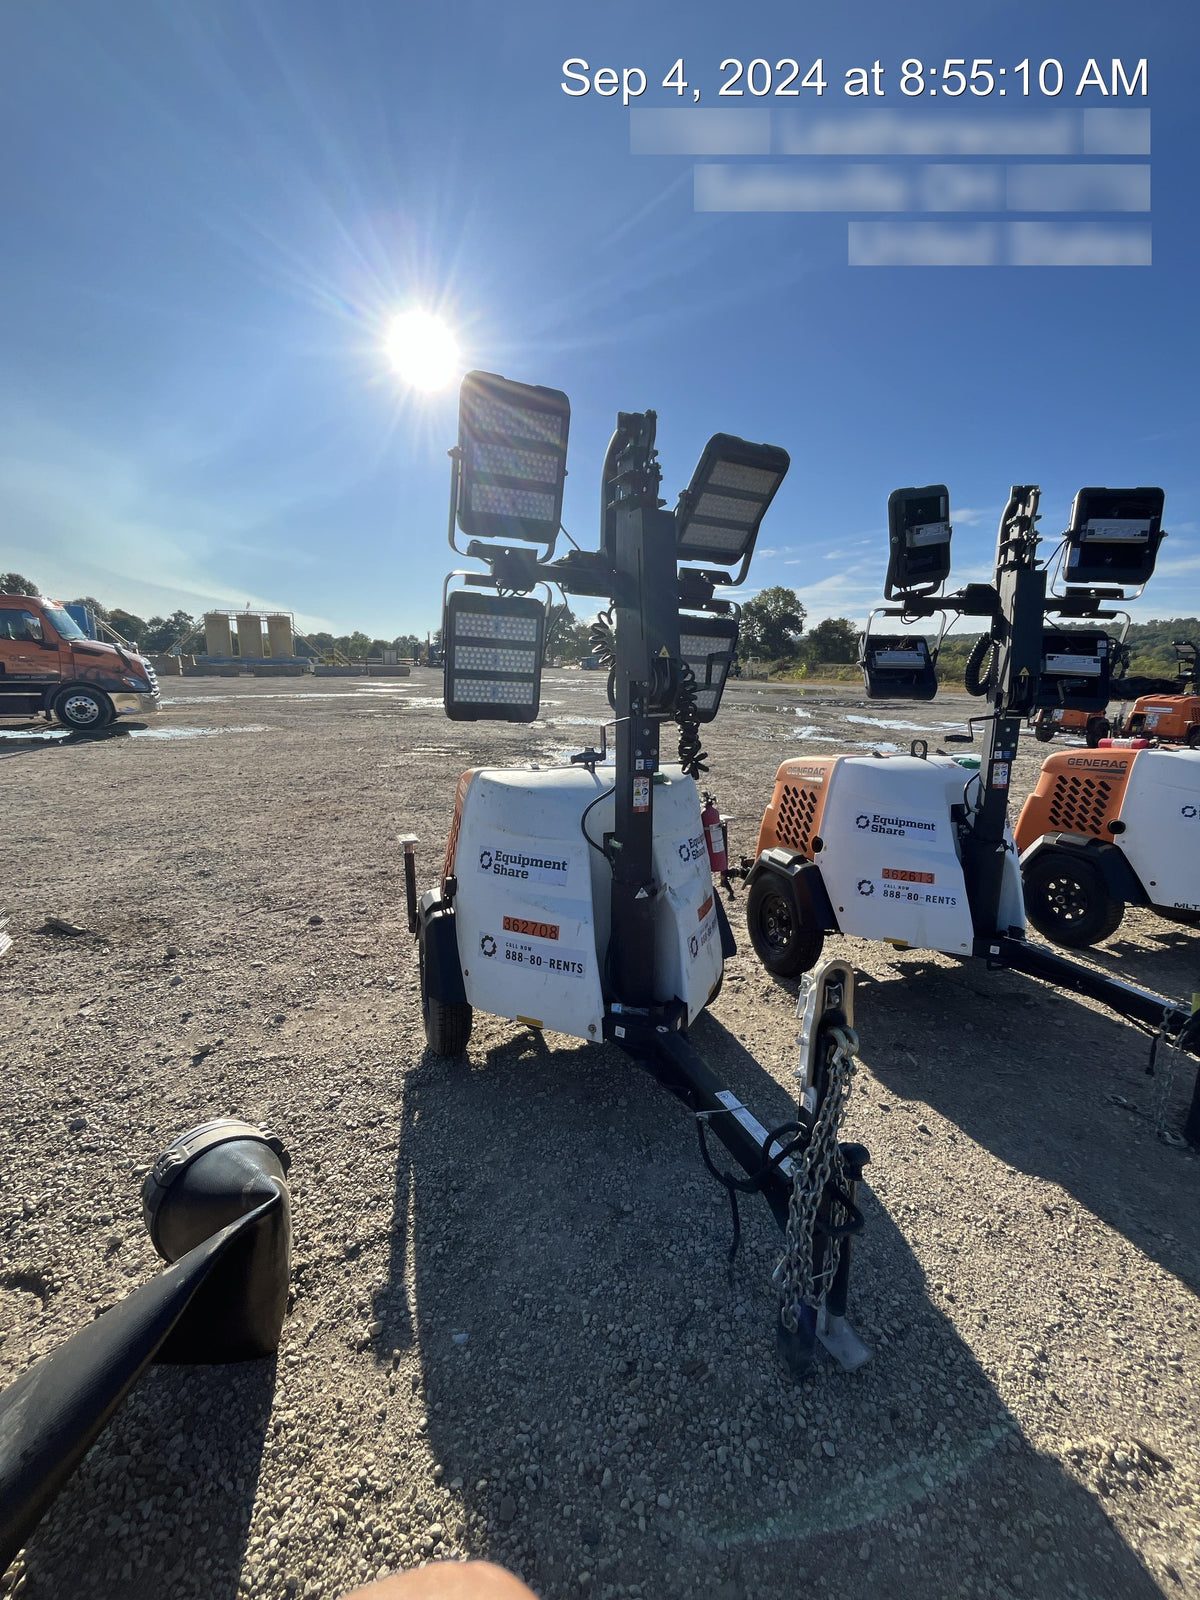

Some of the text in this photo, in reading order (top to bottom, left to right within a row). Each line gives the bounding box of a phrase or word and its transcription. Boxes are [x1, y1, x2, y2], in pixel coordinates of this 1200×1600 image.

[1067, 757, 1129, 769] GENERAC
[871, 824, 905, 836] Share
[872, 814, 936, 831] Equipment
[494, 850, 568, 871] Equipment
[493, 863, 529, 879] Share
[883, 868, 934, 884] 362613
[882, 889, 957, 906] 888-80-RENTS
[503, 916, 559, 940] 362708
[505, 941, 519, 950] CALL
[505, 949, 584, 974] 888-80-RENTS
